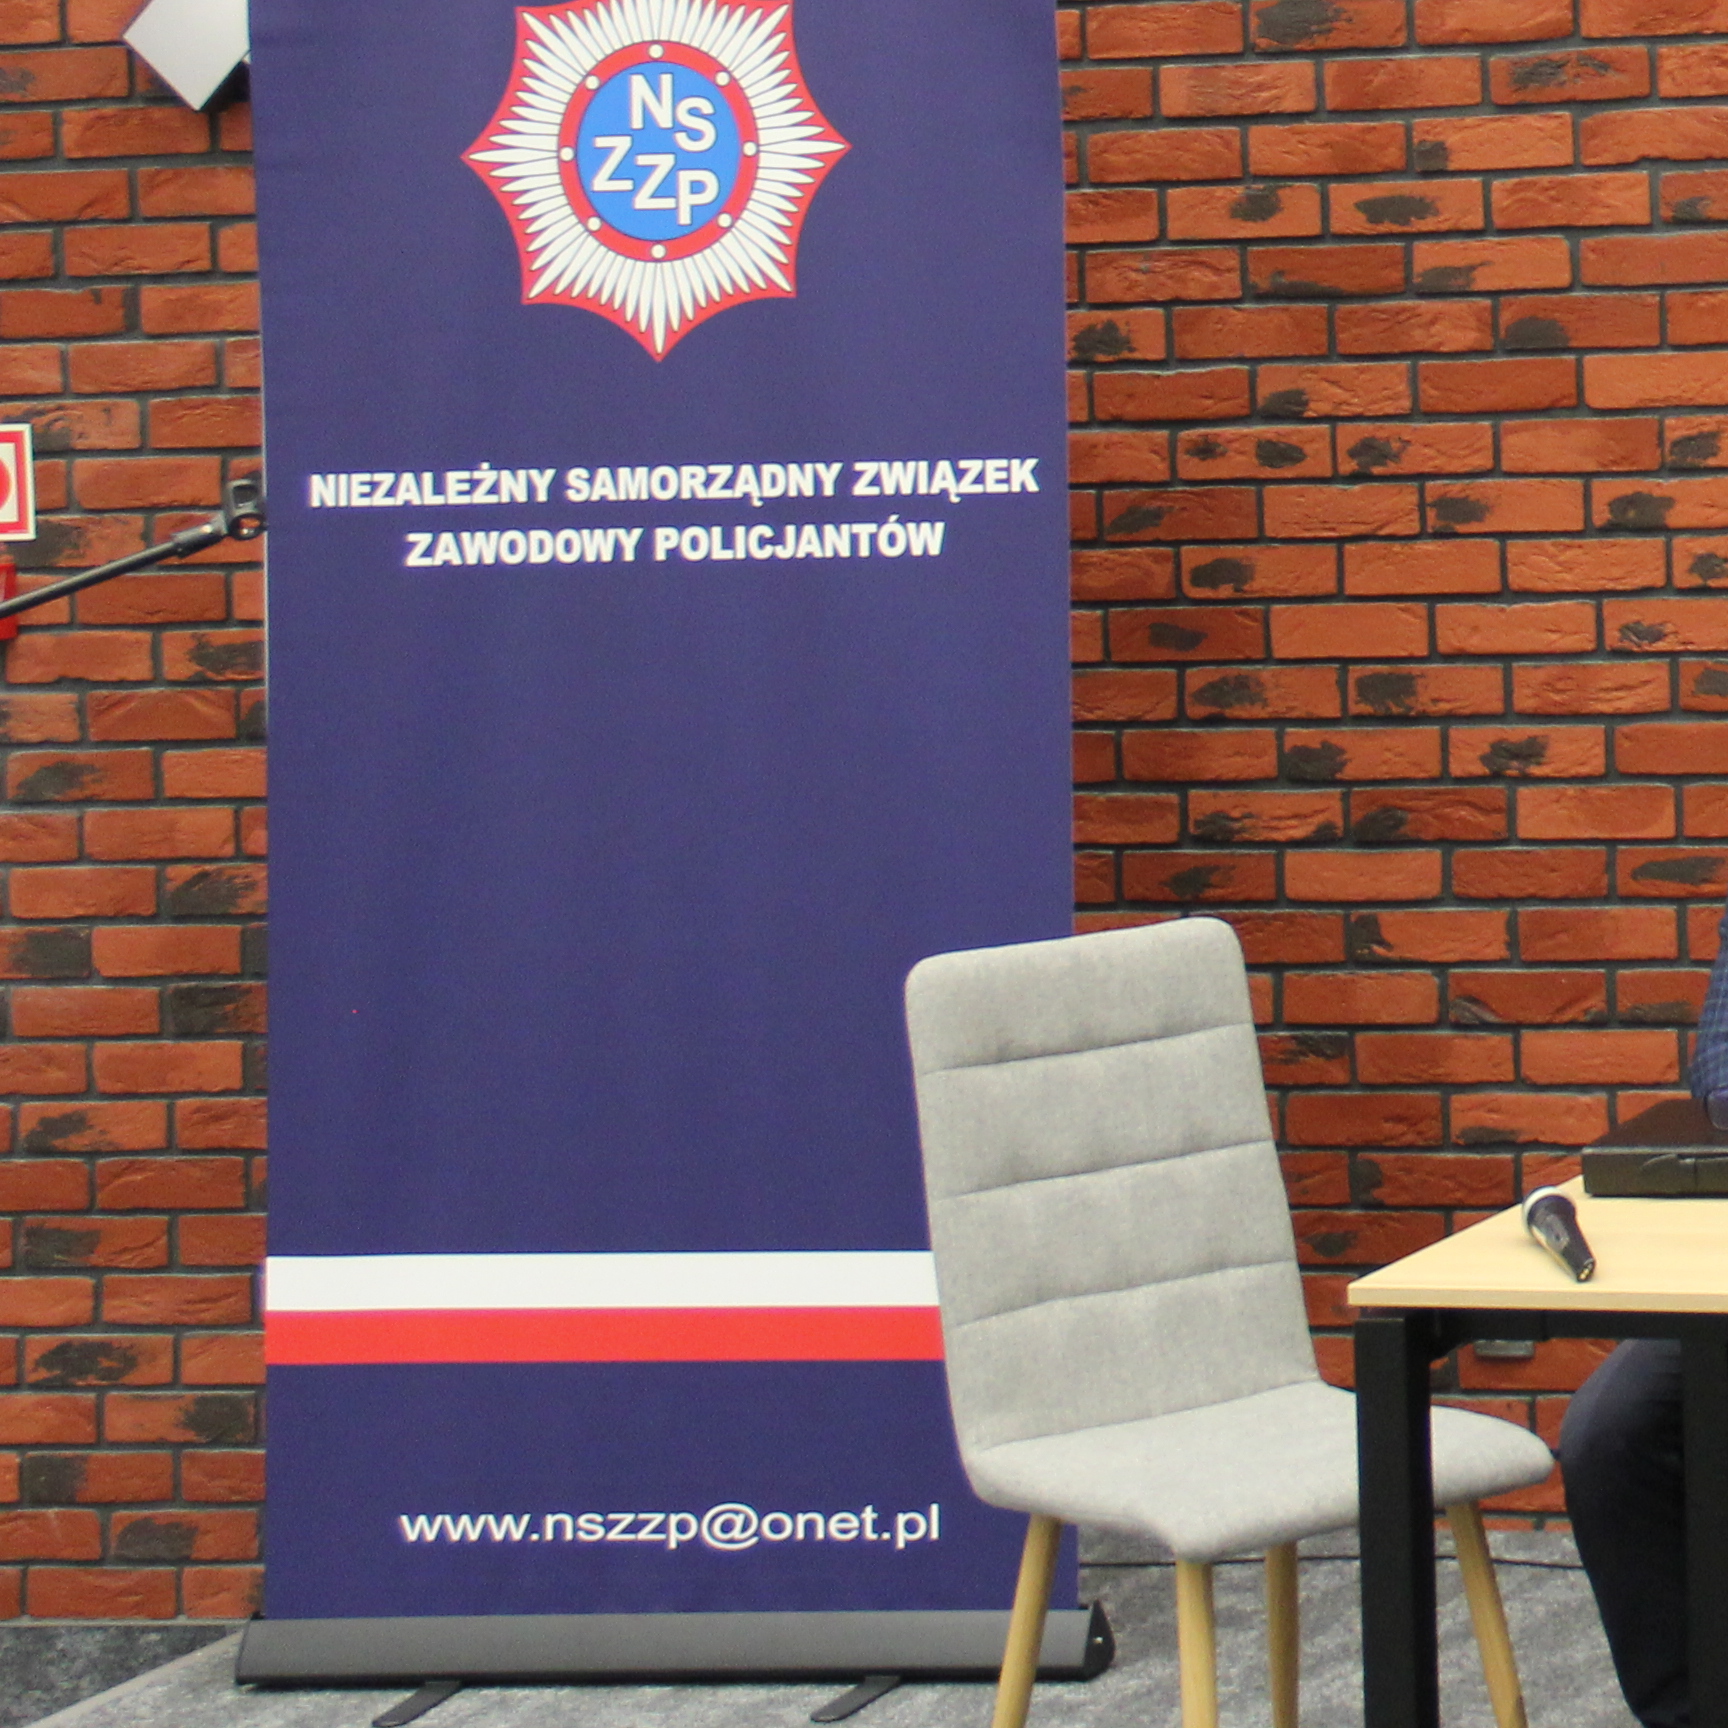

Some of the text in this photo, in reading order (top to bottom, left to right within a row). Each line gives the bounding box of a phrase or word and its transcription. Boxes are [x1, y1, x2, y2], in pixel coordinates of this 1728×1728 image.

[308, 458, 1040, 508] NIEZALEŻNY SAMORZĄDNY ZWIĄZEK
[404, 514, 946, 568] ZAWODOWY POLICJANTÓW
[398, 1503, 940, 1551] www.nszzp@onet.pl
